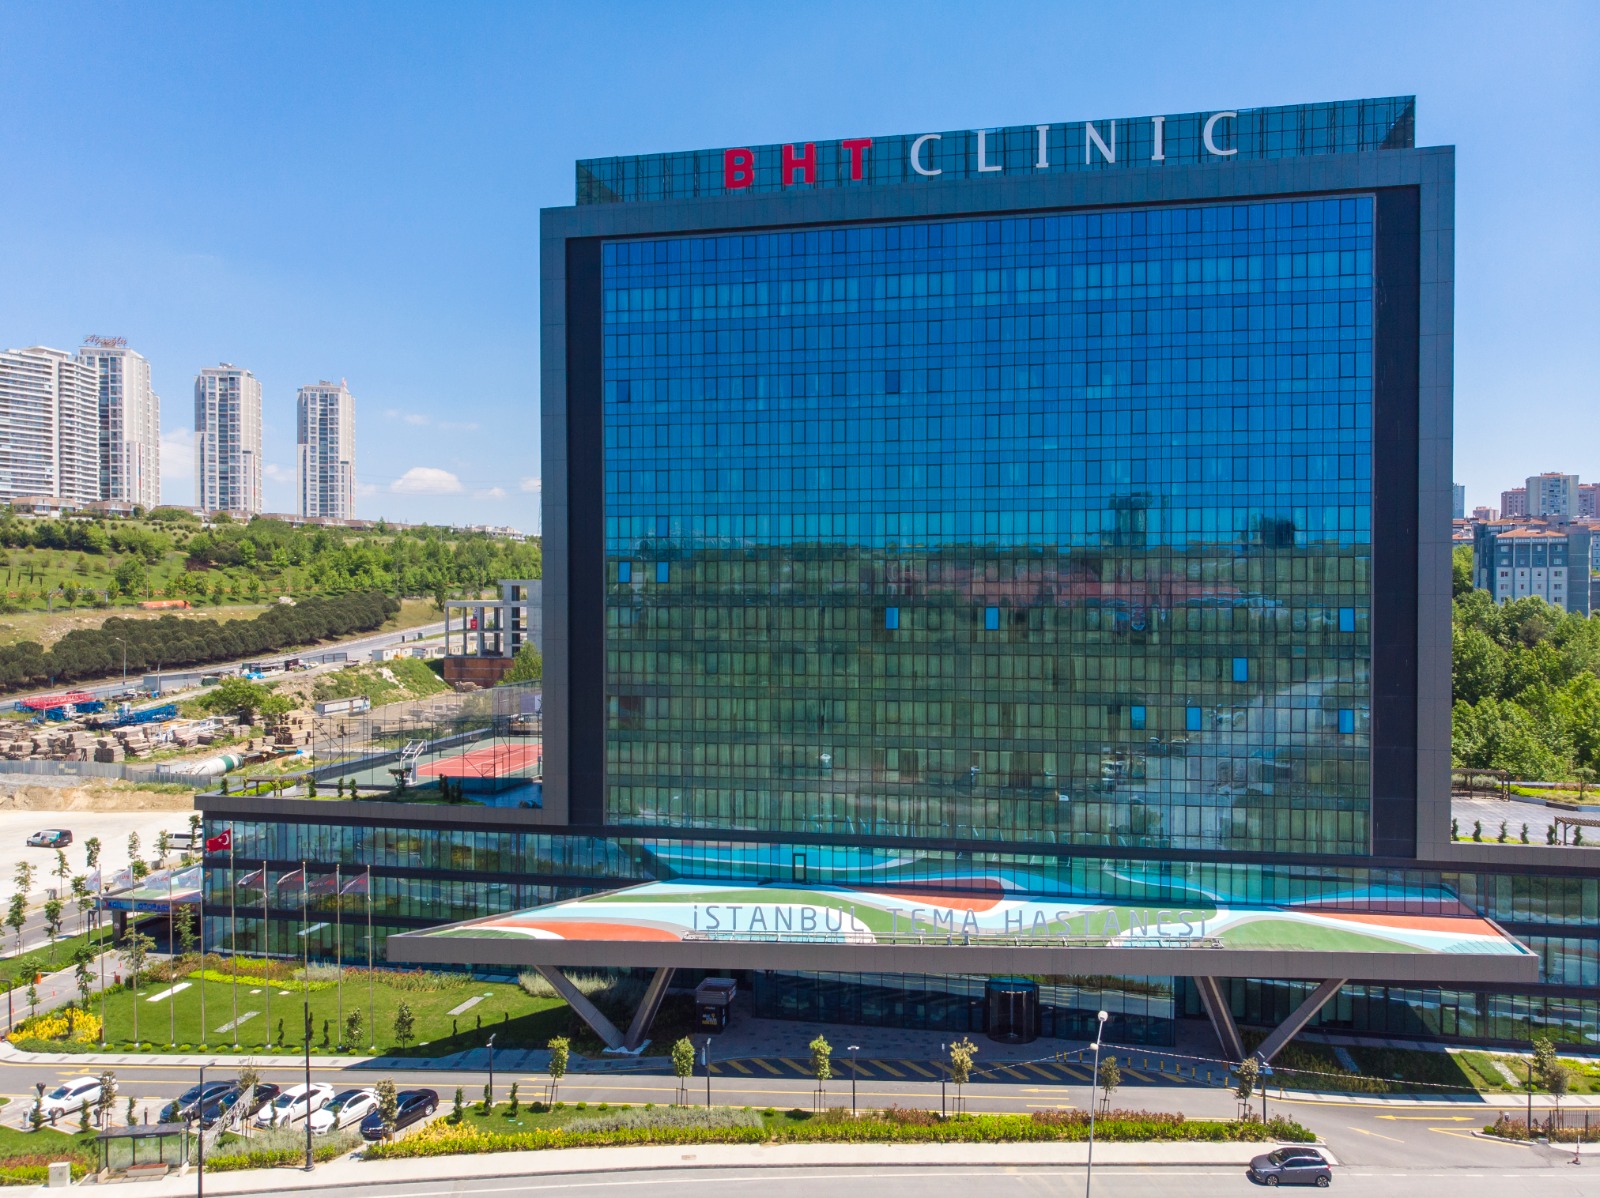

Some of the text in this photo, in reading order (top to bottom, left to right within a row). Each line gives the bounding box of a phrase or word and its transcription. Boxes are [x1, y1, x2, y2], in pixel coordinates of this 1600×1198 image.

[723, 111, 1239, 190] BHT CLINIC
[886, 907, 981, 935] TEMA
[1004, 909, 1207, 937] HASTANESİ
